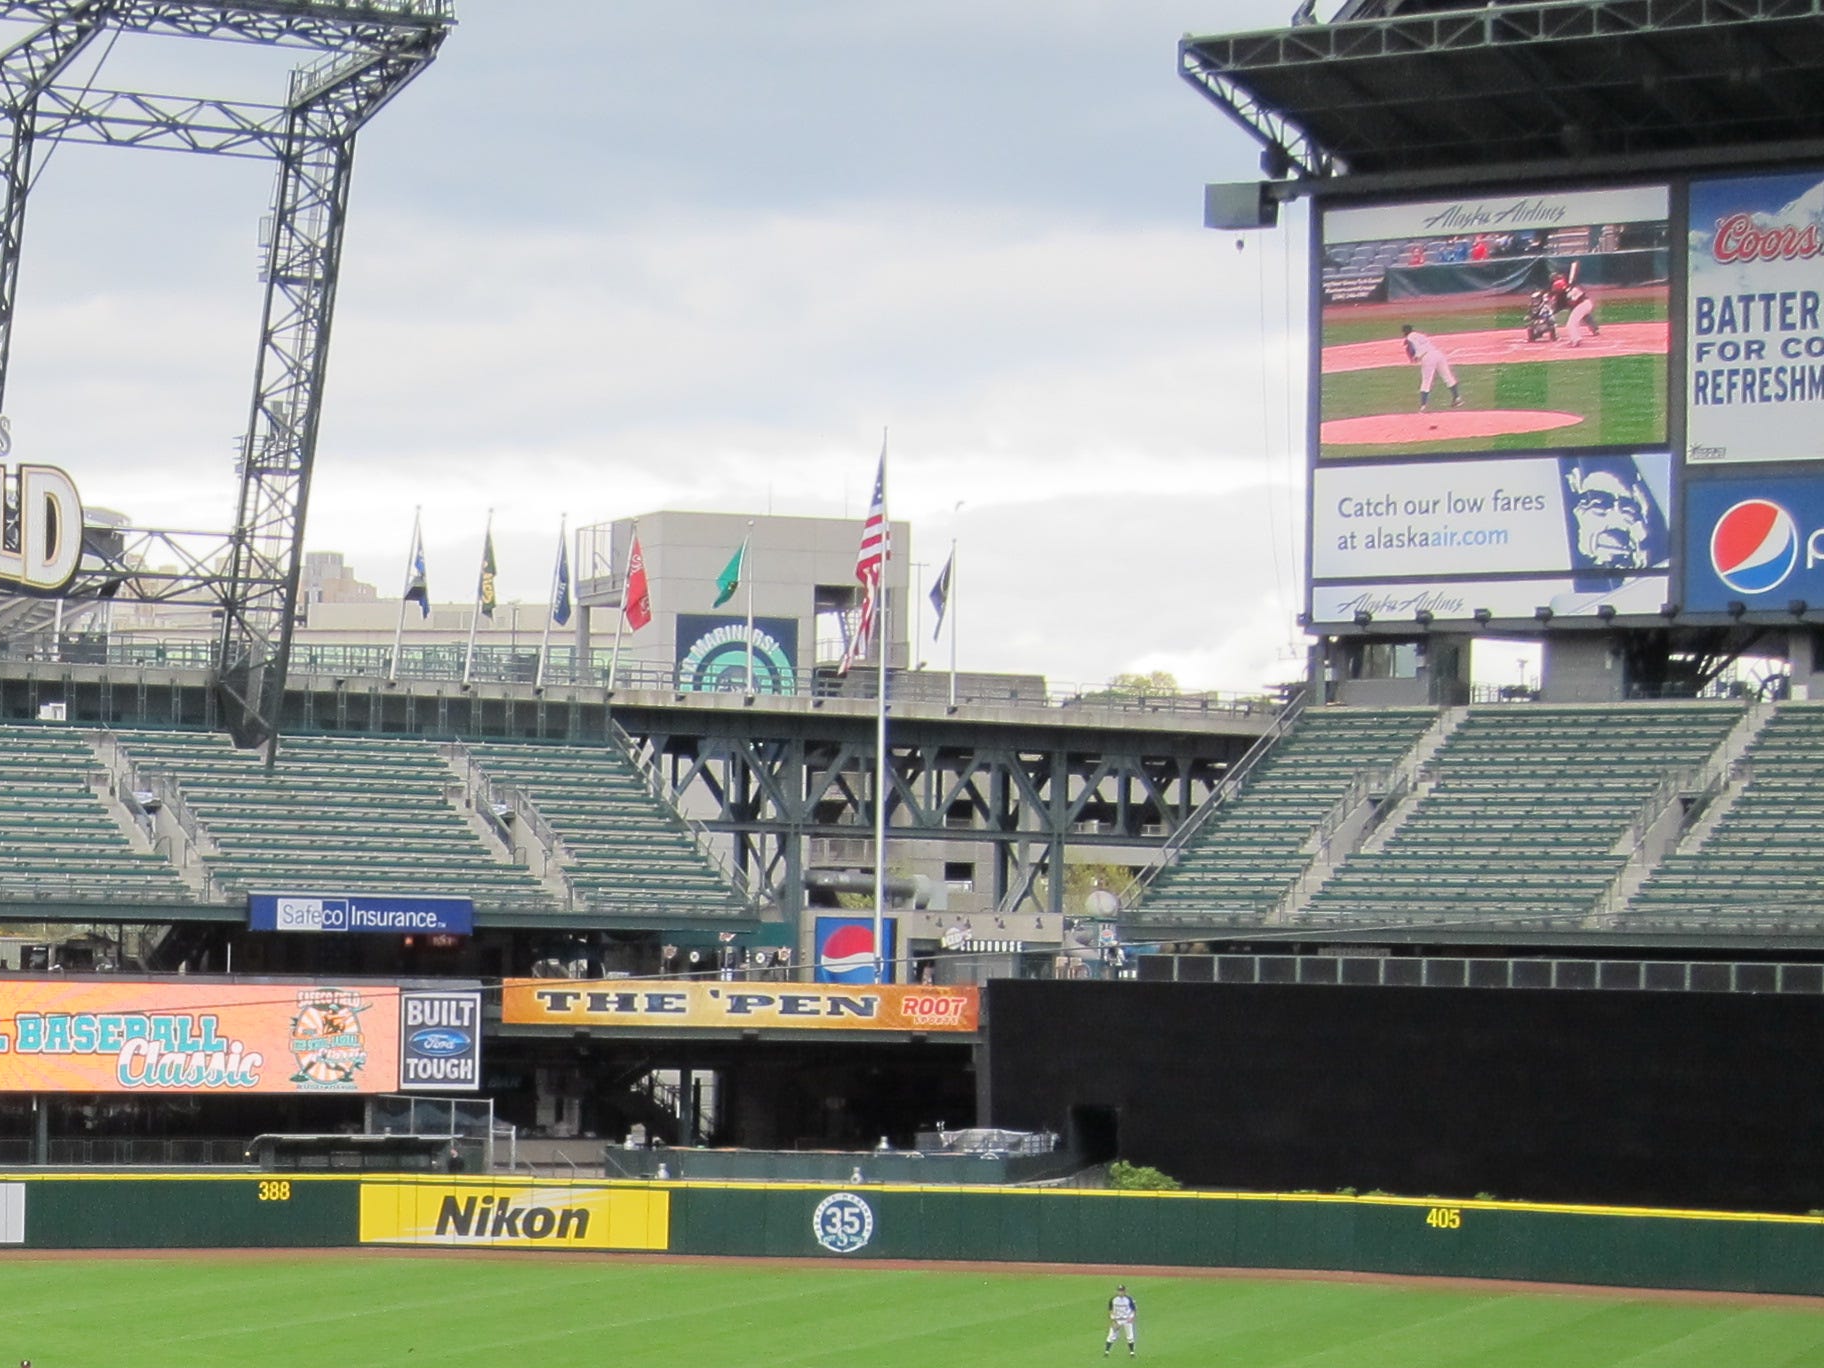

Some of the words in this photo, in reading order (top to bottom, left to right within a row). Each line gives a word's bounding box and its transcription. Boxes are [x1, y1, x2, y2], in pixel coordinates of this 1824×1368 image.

[1425, 205, 1490, 229] Alaska
[1491, 199, 1568, 223] Airlines
[1713, 212, 1819, 263] Coors
[1695, 290, 1820, 336] BATTER
[1695, 339, 1767, 363] FOR
[1337, 493, 1398, 518] Catch
[1404, 498, 1441, 515] our
[1446, 490, 1486, 515] low
[1492, 488, 1546, 513] fares
[1337, 533, 1358, 551] at
[1364, 524, 1509, 550] alaskaair.com
[1336, 592, 1398, 614] Alaska
[1398, 590, 1465, 613] Airlines
[282, 903, 344, 926] Safeco
[350, 905, 438, 928] Insurance
[297, 990, 334, 1007] SAFECO
[334, 991, 361, 1007] FIELD
[537, 990, 687, 1014] THE
[902, 996, 966, 1016] ROOT
[406, 999, 475, 1027] BUILT
[15, 1013, 226, 1054] BASEBALL
[423, 1033, 457, 1050] Ford
[117, 1038, 262, 1088] Classic
[405, 1057, 473, 1080] TOUGH
[258, 1181, 291, 1201] 388
[434, 1195, 591, 1239] Nikon
[825, 1206, 861, 1235] 35
[1426, 1207, 1461, 1229] 405
